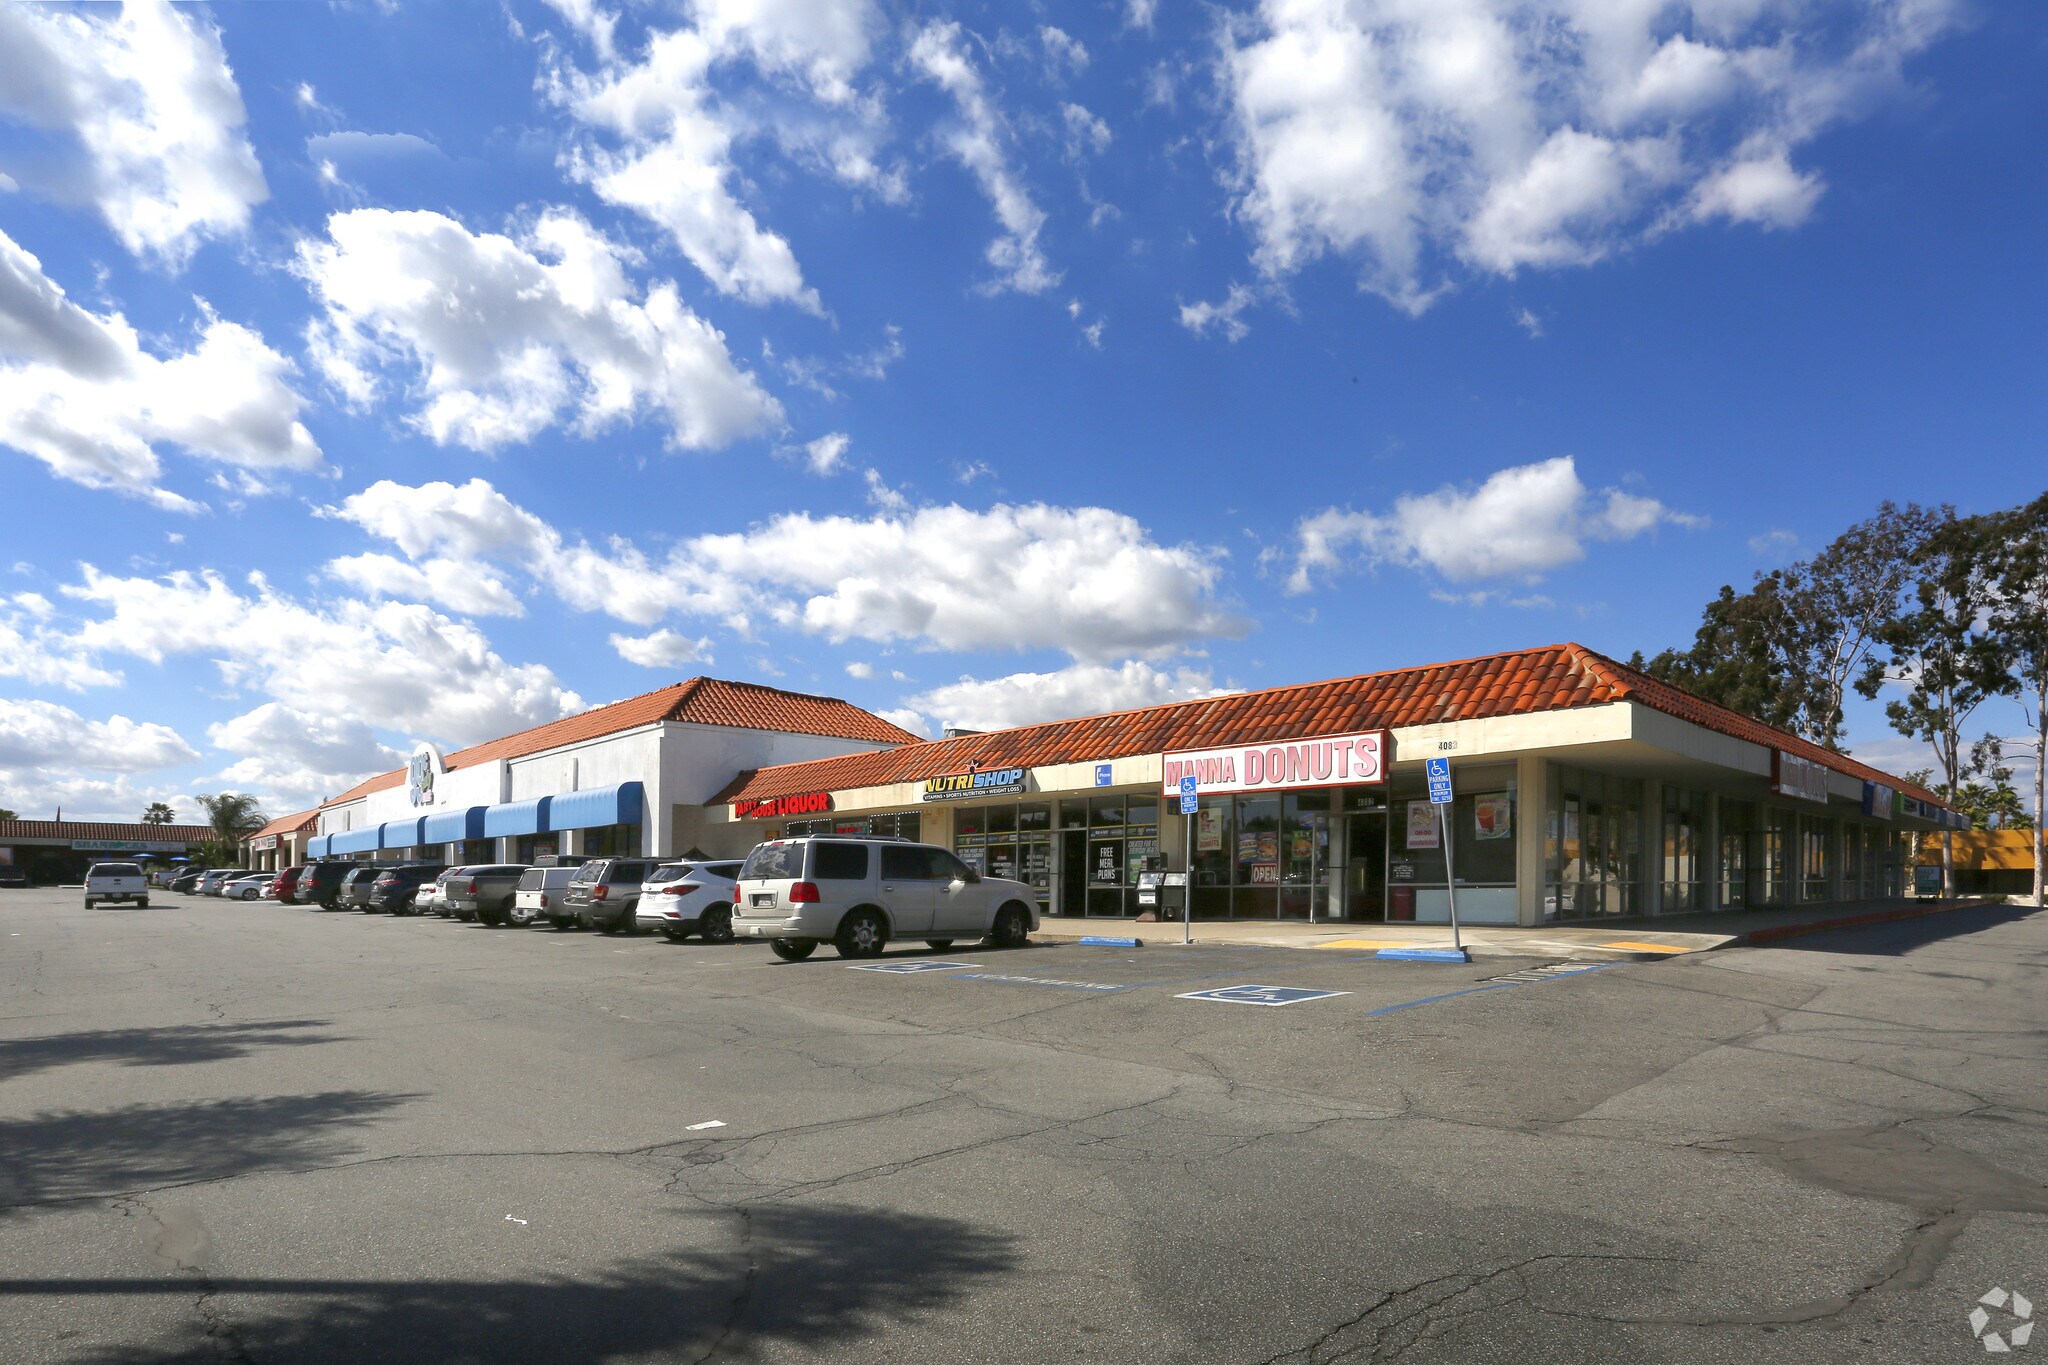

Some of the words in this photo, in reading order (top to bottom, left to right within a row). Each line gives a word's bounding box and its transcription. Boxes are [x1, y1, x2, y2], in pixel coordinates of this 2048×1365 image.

[1166, 756, 1236, 787] MANNA
[1244, 738, 1377, 785] DONUTS
[924, 769, 1023, 793] NUTRISHOP
[735, 800, 757, 817] PARTY
[752, 802, 776, 817] HOUSE
[778, 792, 828, 815] LIQUOR
[1100, 847, 1113, 857] FREE
[1128, 840, 1144, 848] CREATED
[1099, 858, 1114, 868] MEAL
[1097, 869, 1116, 880] PLANS
[1253, 865, 1276, 883] OPEN
